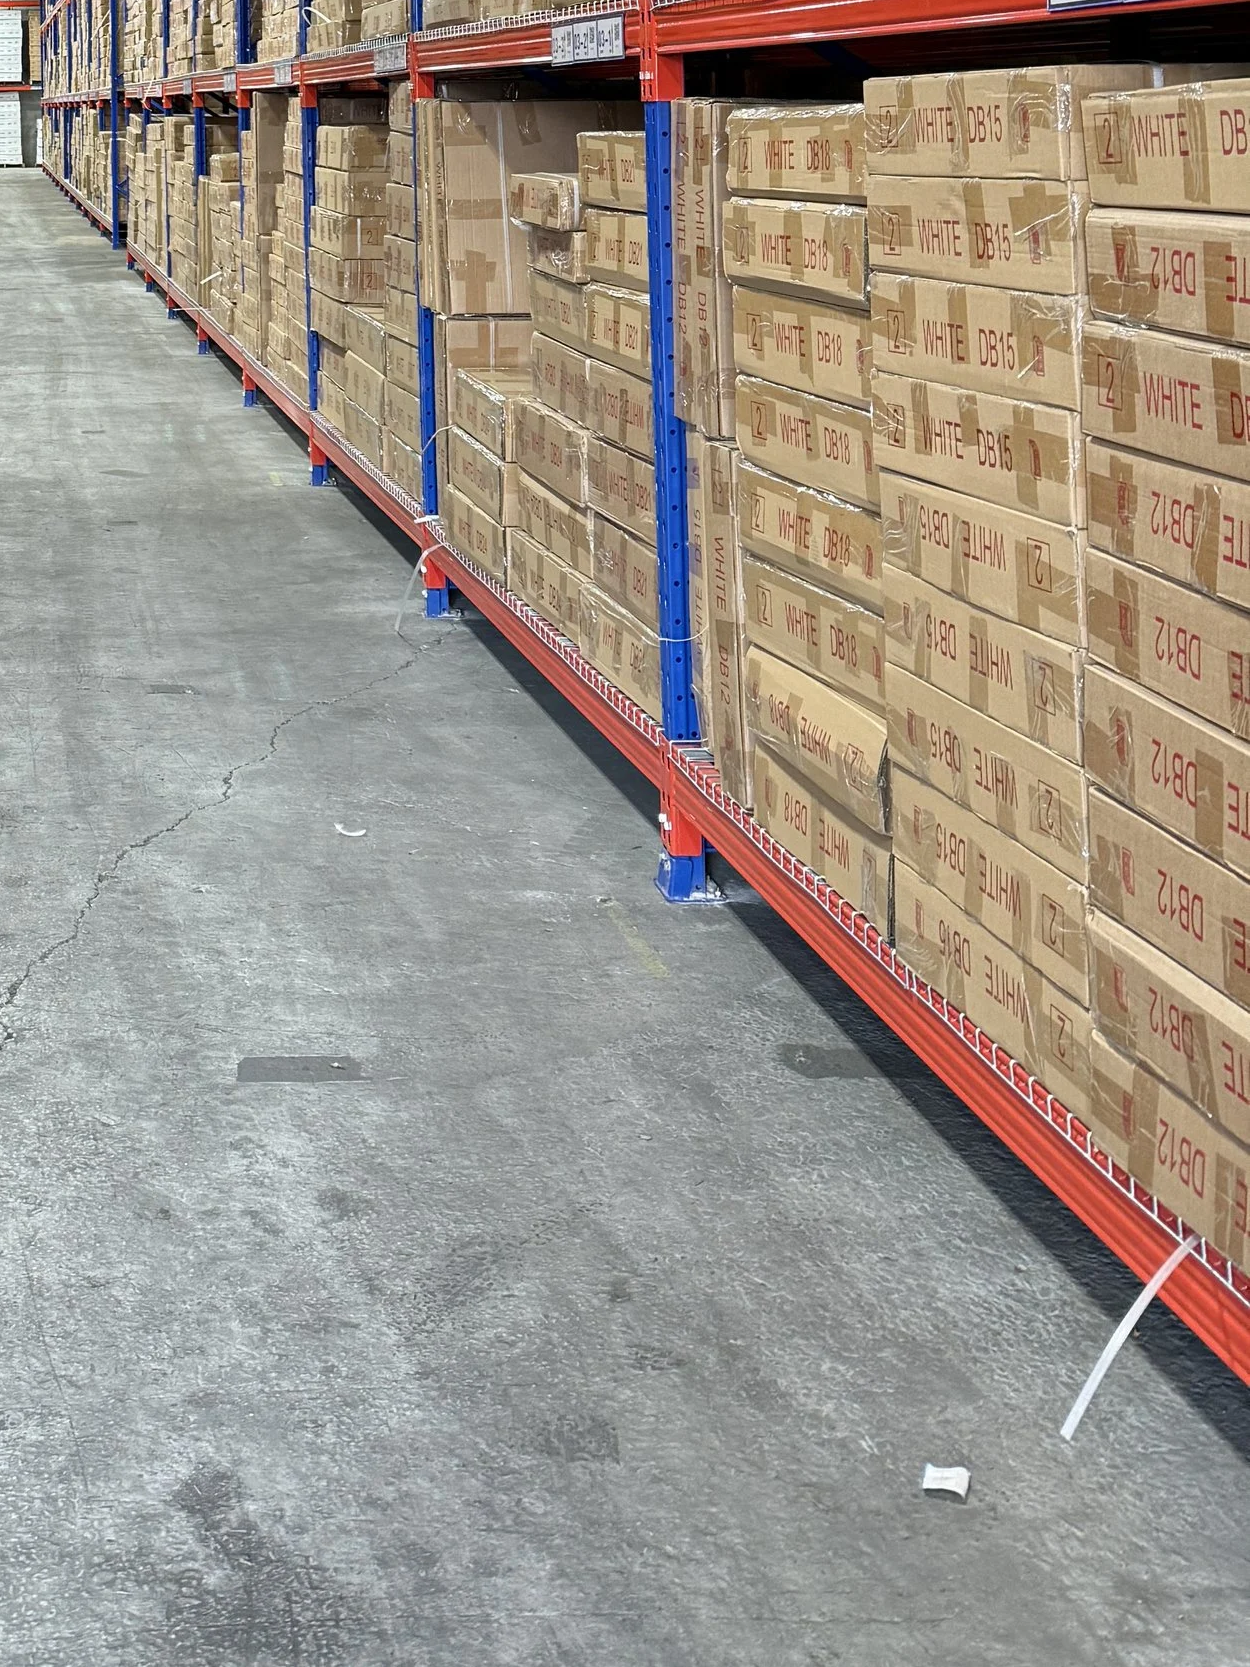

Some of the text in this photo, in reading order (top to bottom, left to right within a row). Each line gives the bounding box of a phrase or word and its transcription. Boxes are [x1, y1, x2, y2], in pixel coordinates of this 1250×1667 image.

[763, 138, 831, 172] WHITE DB18
[913, 104, 1003, 144] WHITE DB15
[1101, 108, 1250, 160] 2 WHITE DB
[677, 183, 687, 252] WHITE
[696, 189, 705, 260] WHITE
[760, 233, 829, 272] WHITE DB18
[884, 216, 1012, 263] 2 WHITE DB15
[1150, 245, 1198, 298] DB12
[749, 316, 843, 367] 2 WHITE DB18
[889, 314, 1016, 372] 2 WHITE DB15
[1103, 360, 1116, 403] 2
[1143, 373, 1204, 431] WHITE
[753, 403, 851, 466] 2 WHITE DB18
[921, 414, 1014, 473] WHITE DB15
[753, 497, 851, 568] 2 WHITE DB18
[919, 502, 1047, 585] 2 WHITE DB15
[1150, 490, 1197, 551] DB12
[712, 536, 726, 613] WHITE
[759, 592, 859, 669] 2 WHITE DB18
[925, 611, 1051, 709] 2 WHITE DB15
[1155, 615, 1203, 683] DB12
[930, 726, 1019, 810] WHITE DB15
[1150, 738, 1201, 810] DB12
[783, 791, 851, 872] WHITE DB18
[935, 821, 1060, 938] 2 WHITE DB15
[1156, 867, 1205, 943] DB12
[939, 914, 1031, 1025] WHITE DB15
[1149, 986, 1196, 1053] DB12
[1157, 1116, 1208, 1201] DB12
